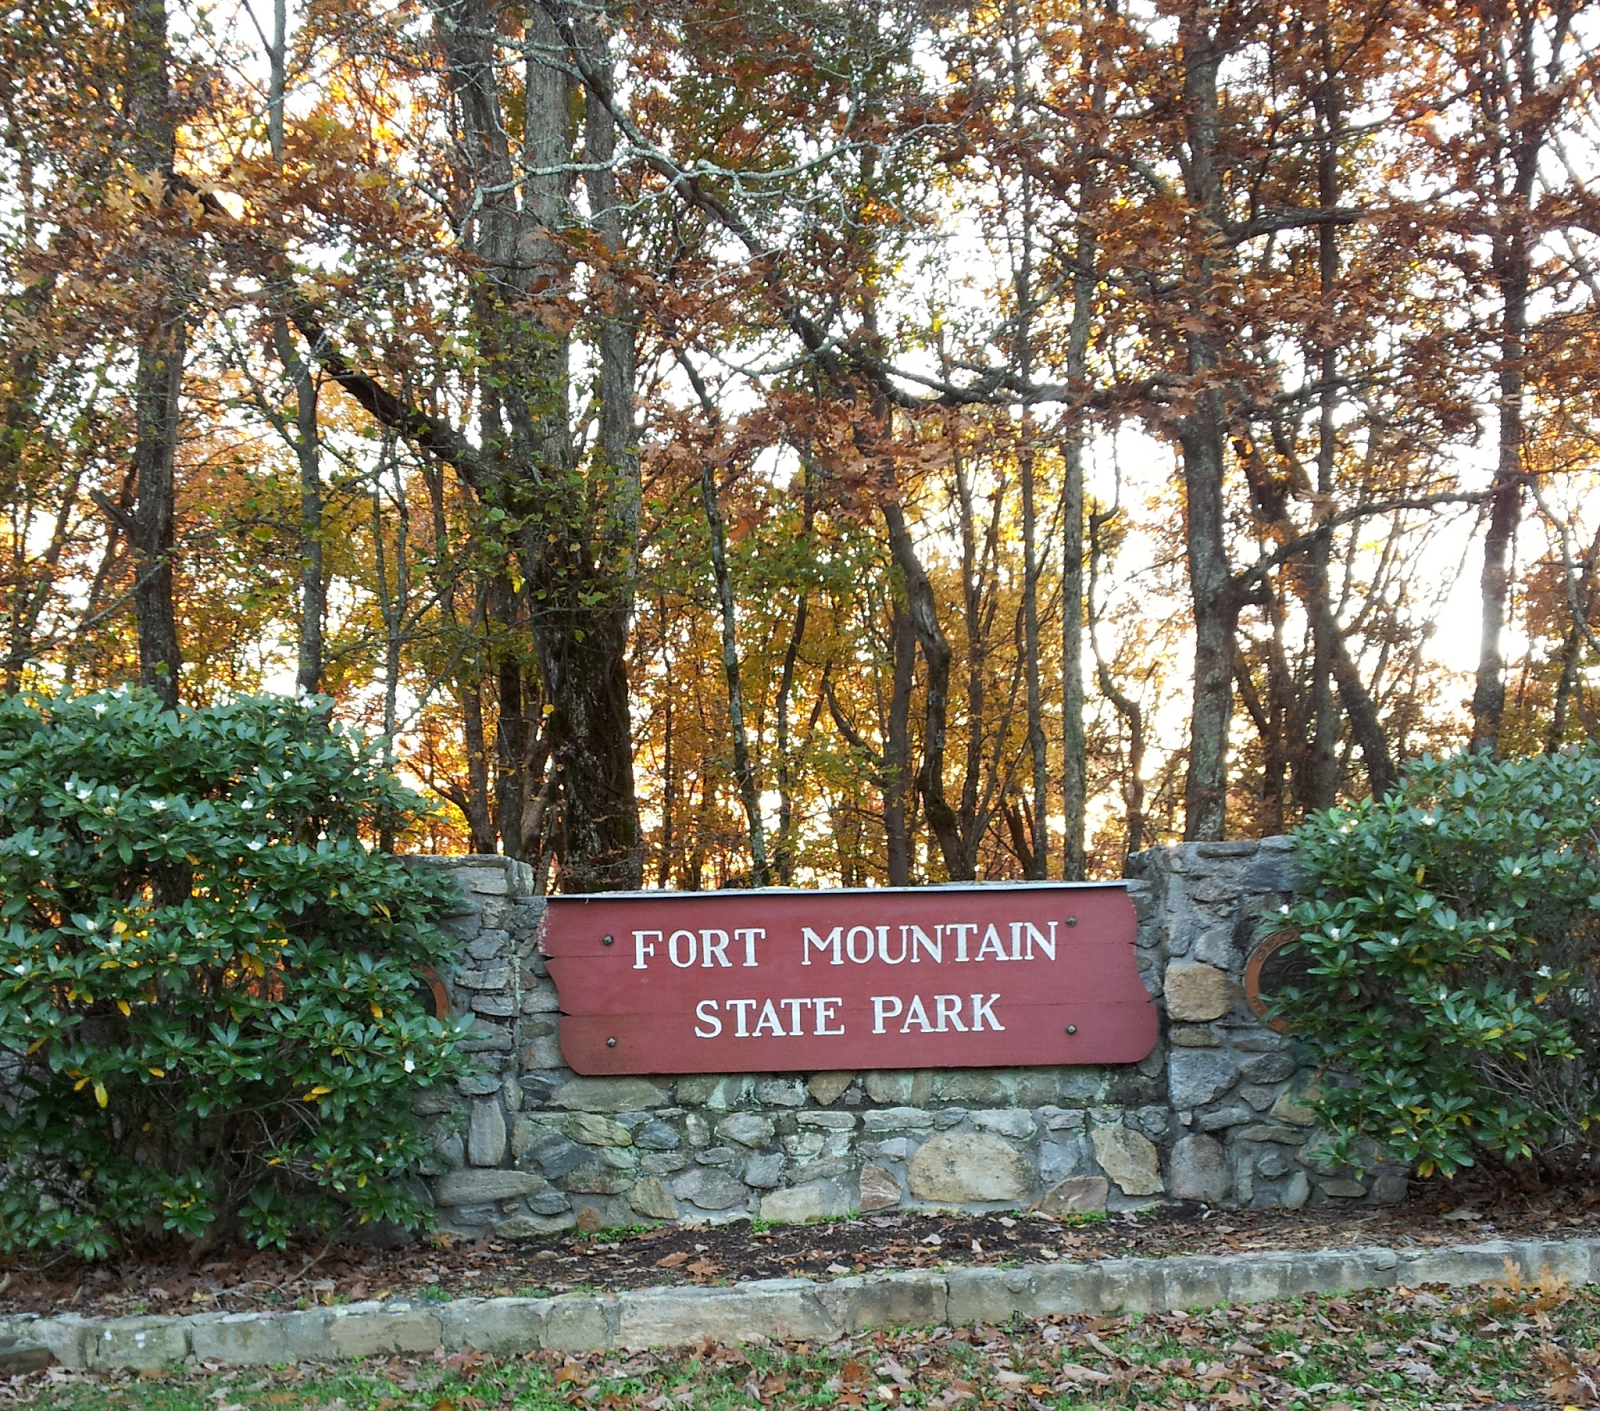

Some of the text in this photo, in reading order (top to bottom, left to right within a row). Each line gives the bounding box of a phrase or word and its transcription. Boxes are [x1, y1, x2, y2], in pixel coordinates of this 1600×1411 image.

[631, 921, 1059, 970] FORT MOUNTAIN
[694, 993, 1006, 1039] STATE PARK
